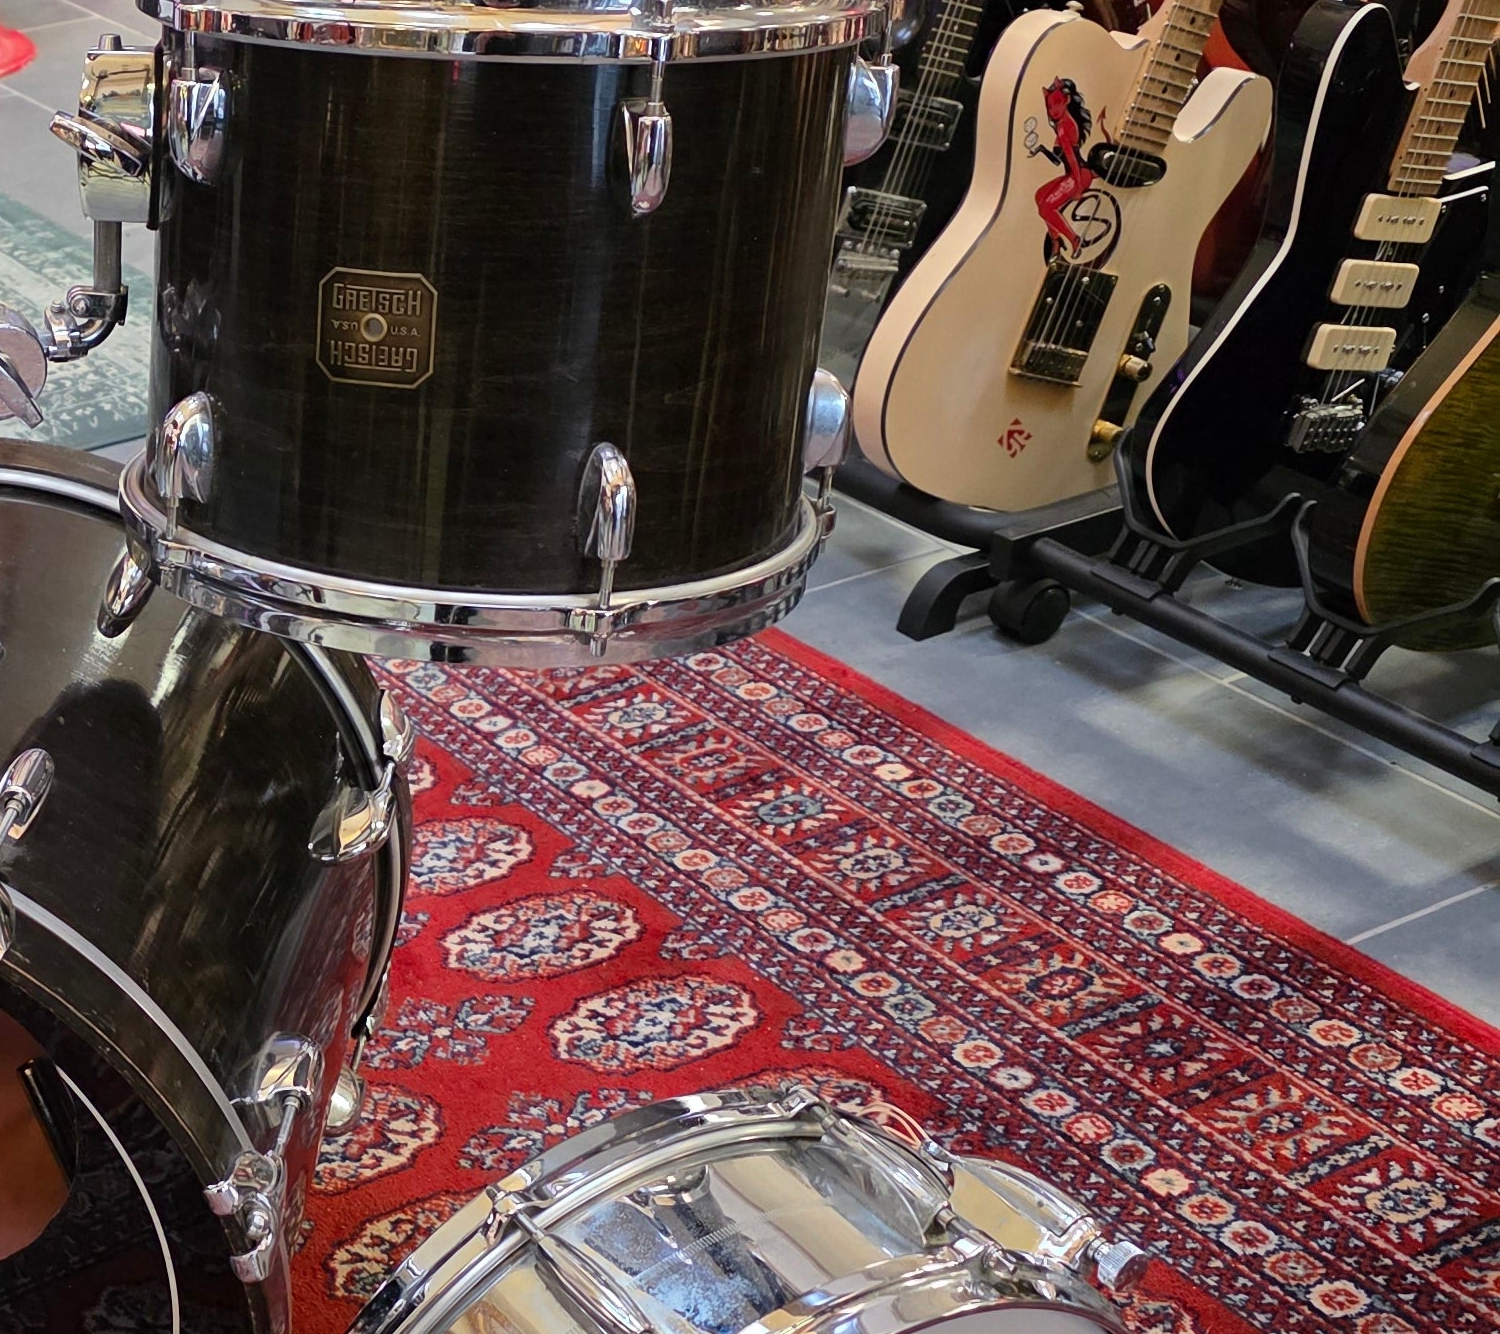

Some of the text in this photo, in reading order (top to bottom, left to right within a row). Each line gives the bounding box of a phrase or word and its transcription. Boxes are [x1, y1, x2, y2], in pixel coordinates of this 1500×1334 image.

[332, 283, 422, 316] GRETSCH
[390, 325, 421, 337] U.S.A.
[329, 340, 418, 373] GRETSCH
